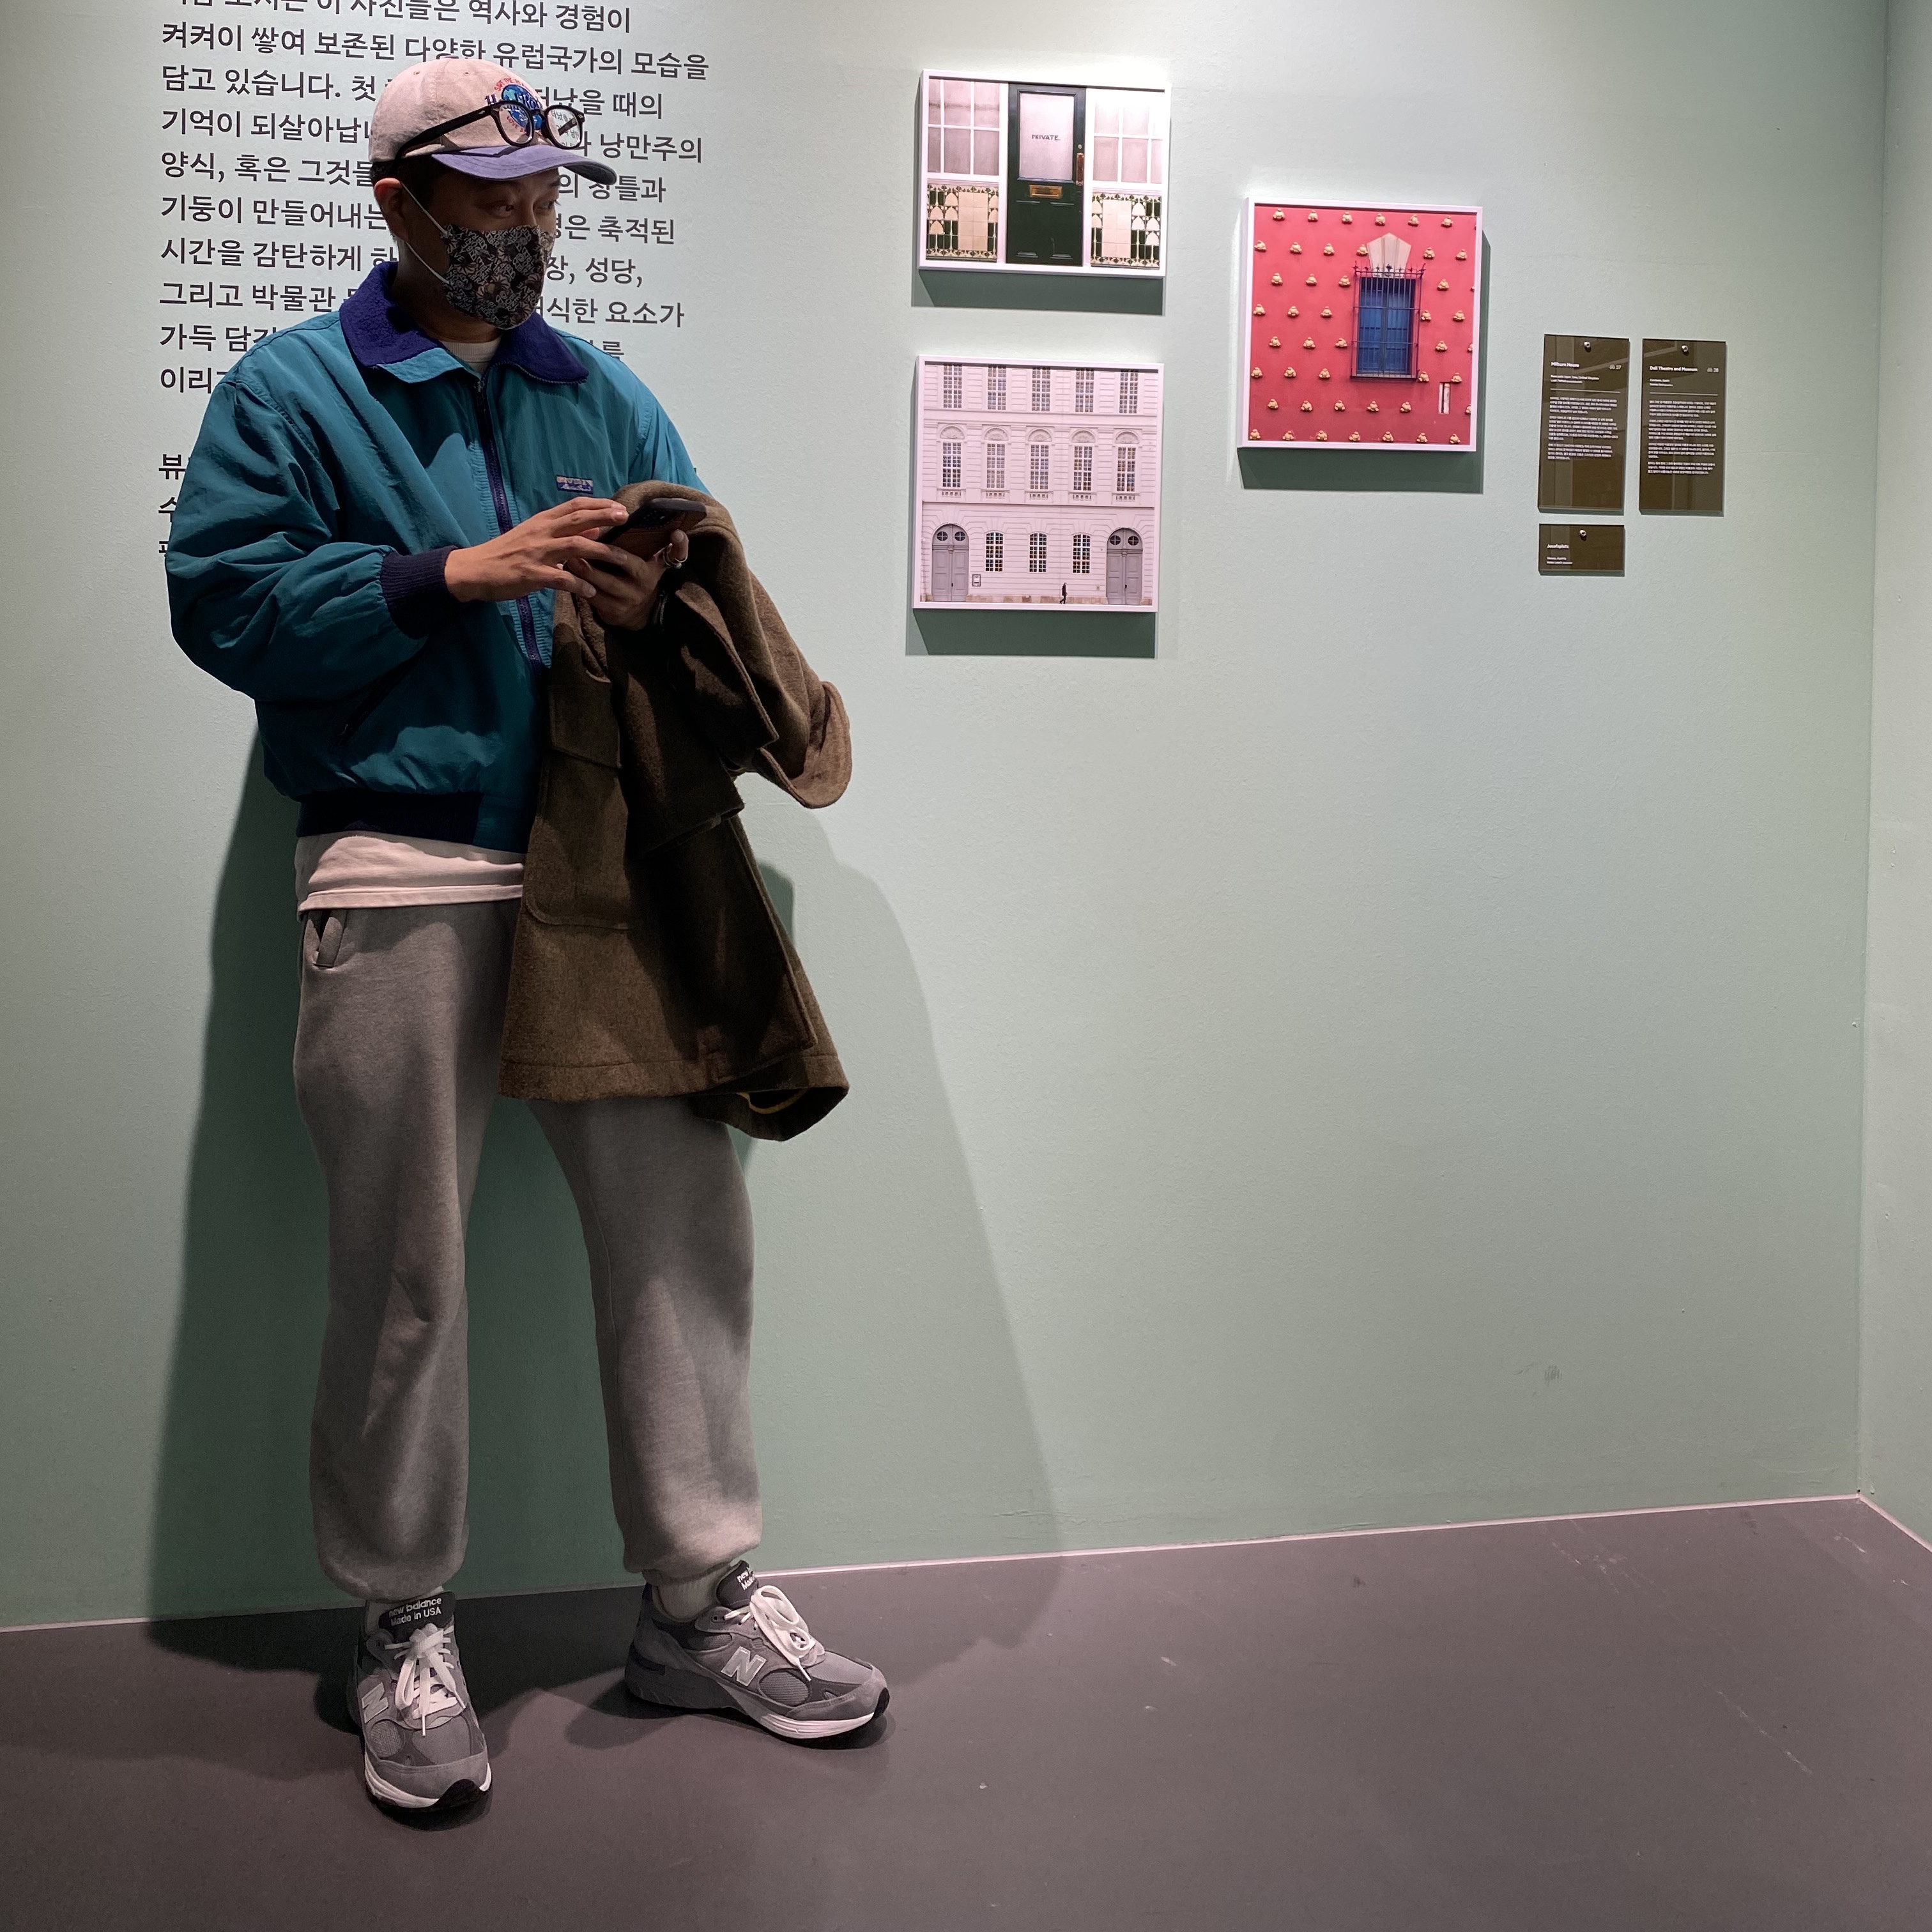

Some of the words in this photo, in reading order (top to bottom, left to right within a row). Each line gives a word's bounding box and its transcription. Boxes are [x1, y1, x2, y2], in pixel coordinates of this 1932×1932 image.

[470, 0, 547, 27] 역사와
[556, 4, 629, 33] 경험이
[163, 22, 241, 51] 켜켜이
[252, 27, 303, 55] 쌓여
[315, 33, 394, 60] 보존된
[493, 42, 622, 75] 유럽국가의
[631, 53, 709, 80] 모습을
[163, 65, 215, 91] 담고
[226, 69, 340, 99] 있습니다.
[352, 76, 376, 101] 첫
[613, 92, 661, 119] 때의
[162, 109, 240, 137] 기억이
[600, 132, 702, 163] 낭만주의
[162, 151, 224, 183] 양식,
[234, 155, 290, 182] 혹은
[162, 195, 241, 223] 기둥이
[253, 198, 387, 230] 만들어내는
[598, 217, 673, 244] 축적된
[161, 238, 244, 266] 시간을
[253, 241, 360, 271] 감탄하게
[586, 258, 641, 288] 성당,
[160, 282, 243, 308] 그리고
[252, 284, 336, 312] 박물관
[606, 302, 684, 327] 요소가
[160, 324, 216, 351] 가득
[160, 367, 227, 394] 이리
[406, 1598, 442, 1613] balance
[414, 1612, 422, 1620] in
[423, 1606, 441, 1618] USA
[721, 1646, 767, 1687] N
